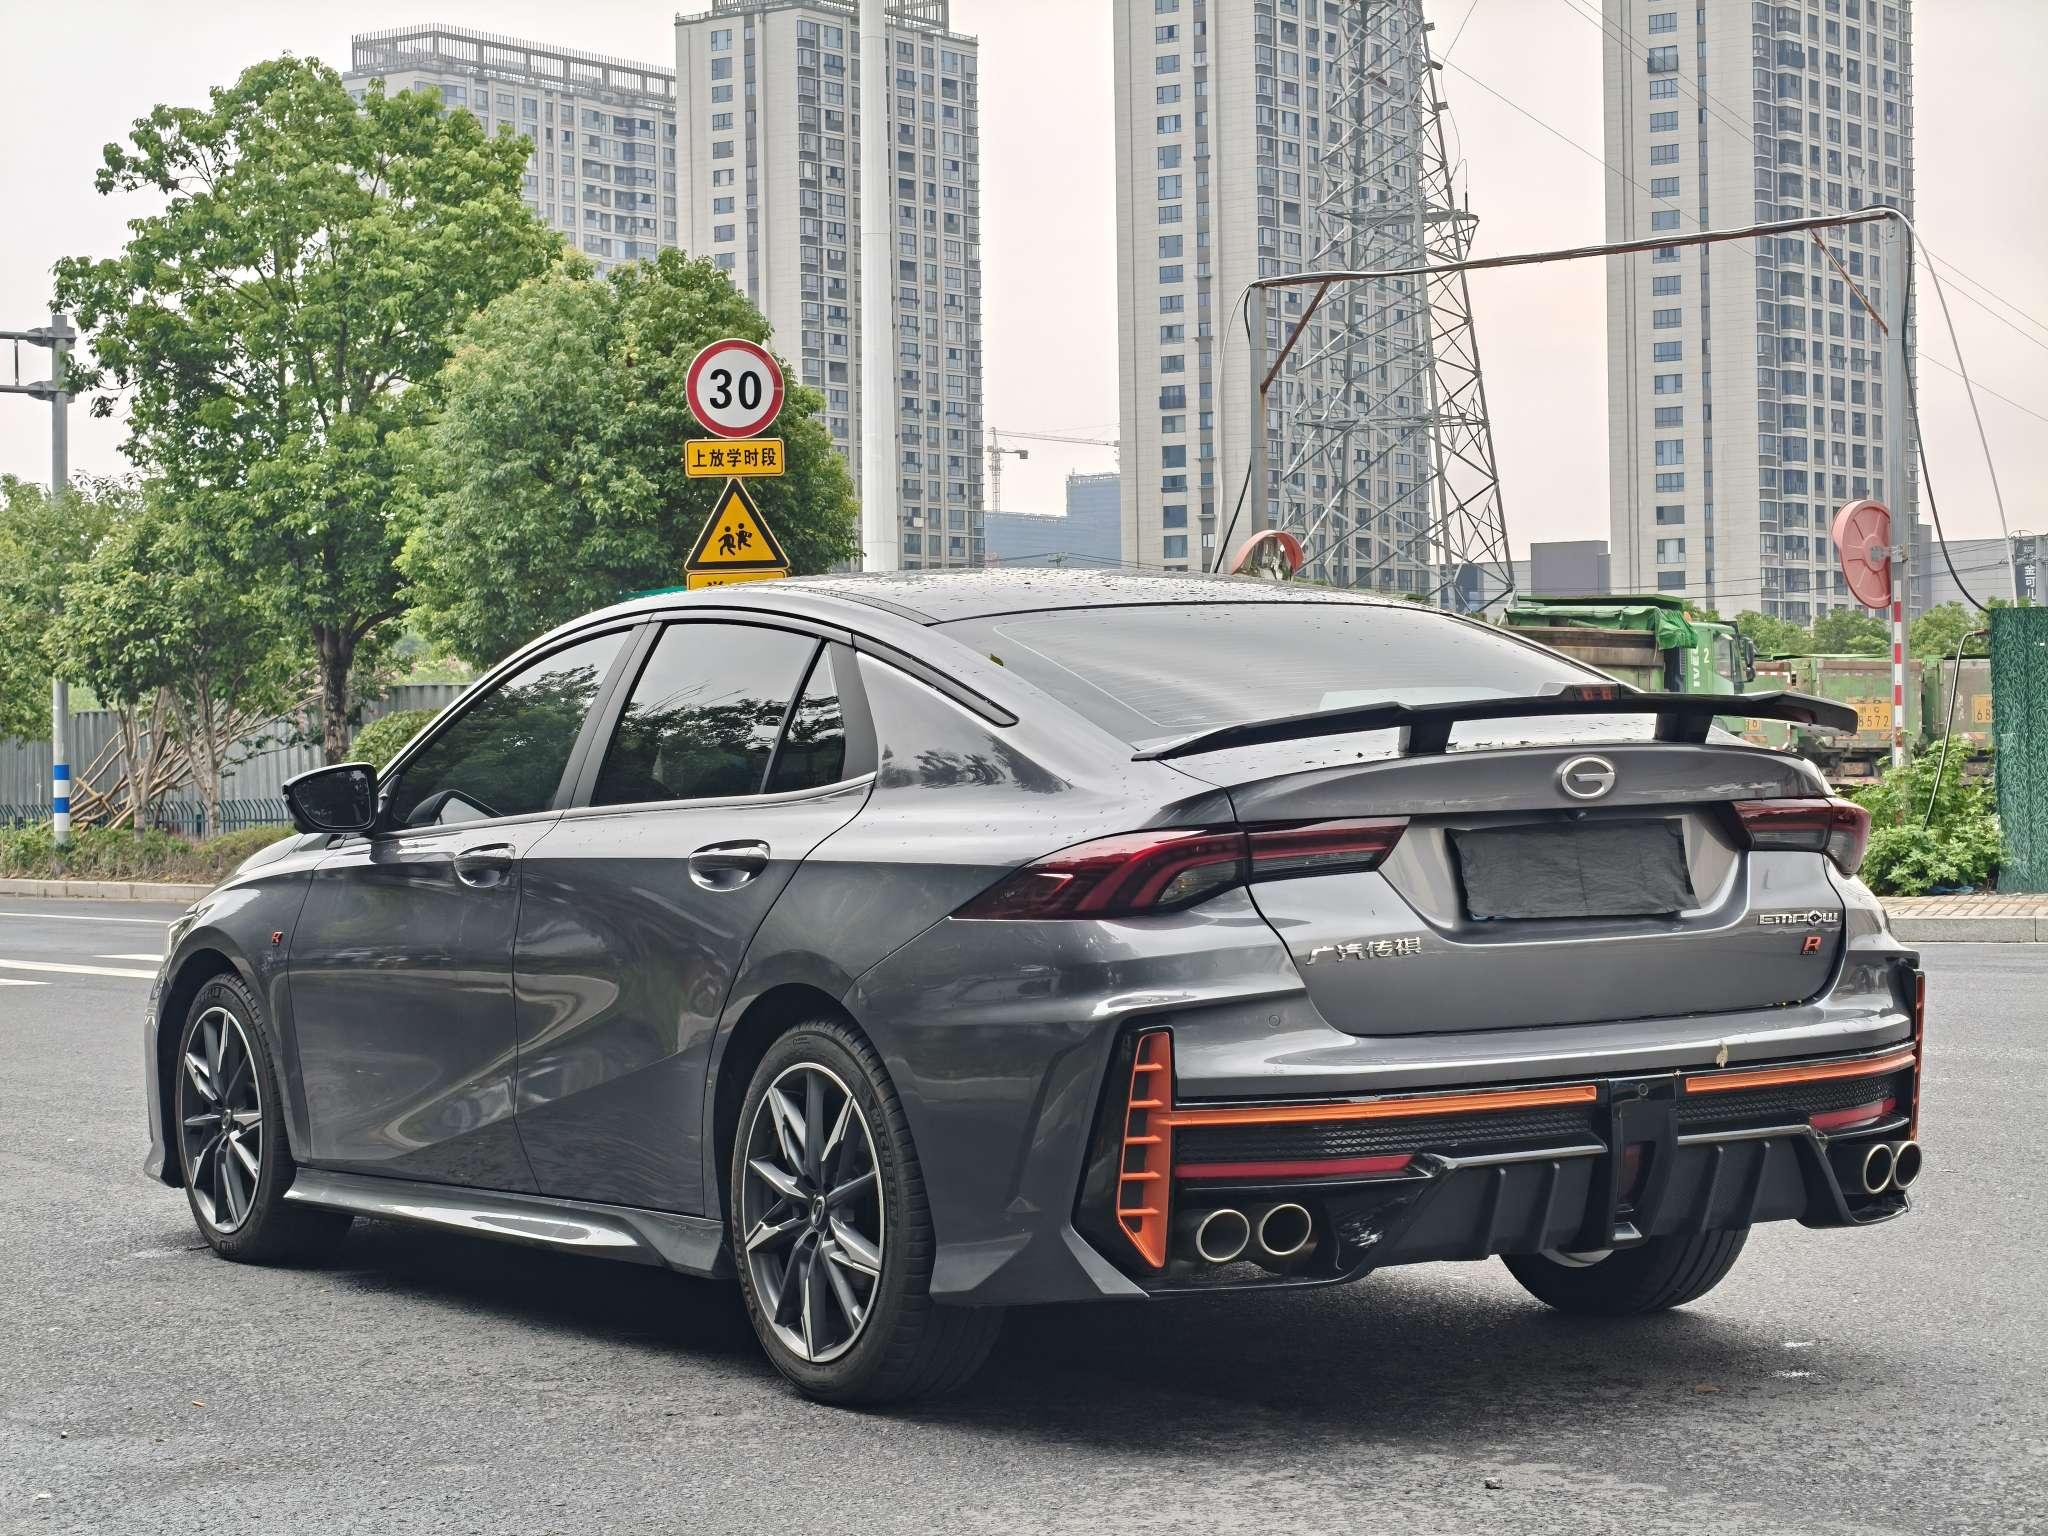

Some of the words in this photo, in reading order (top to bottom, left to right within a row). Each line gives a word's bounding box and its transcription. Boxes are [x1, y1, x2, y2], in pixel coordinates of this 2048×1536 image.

[709, 368, 762, 410] 30
[692, 447, 777, 468] 上放学时段
[1305, 936, 1422, 965] 广汽传祺
